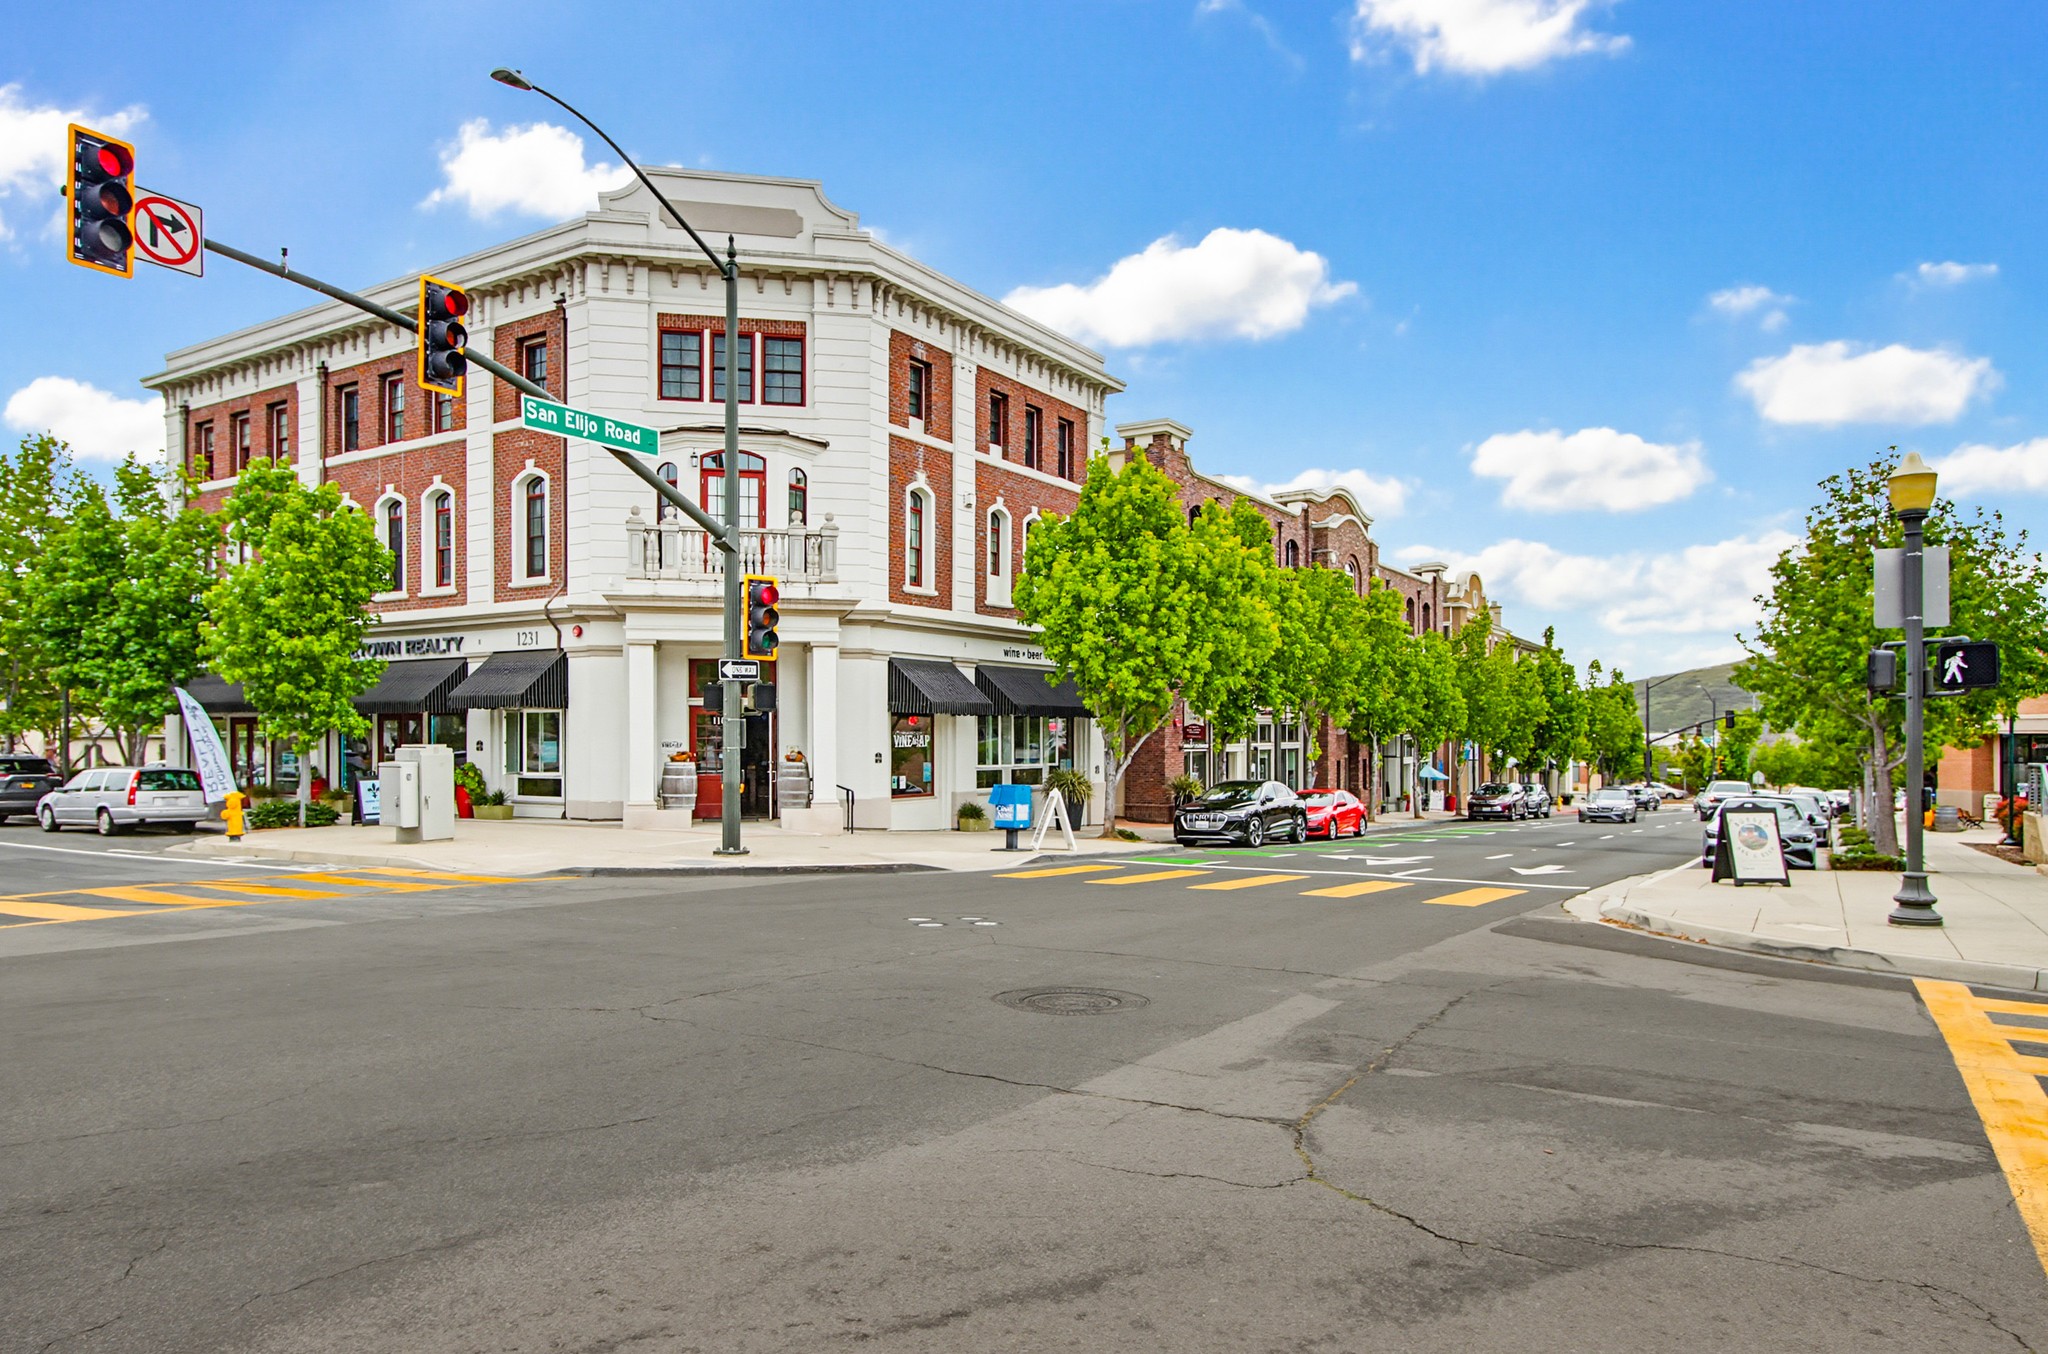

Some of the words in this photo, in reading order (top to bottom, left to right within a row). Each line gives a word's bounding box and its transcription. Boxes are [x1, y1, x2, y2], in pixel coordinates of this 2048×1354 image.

[526, 401, 558, 424] San
[565, 411, 598, 437] Elijo
[605, 421, 641, 445] Road
[405, 636, 465, 655] REALTY
[517, 631, 539, 646] 1231
[1003, 646, 1021, 659] wine
[1027, 648, 1043, 660] beer
[893, 734, 913, 748] VINE
